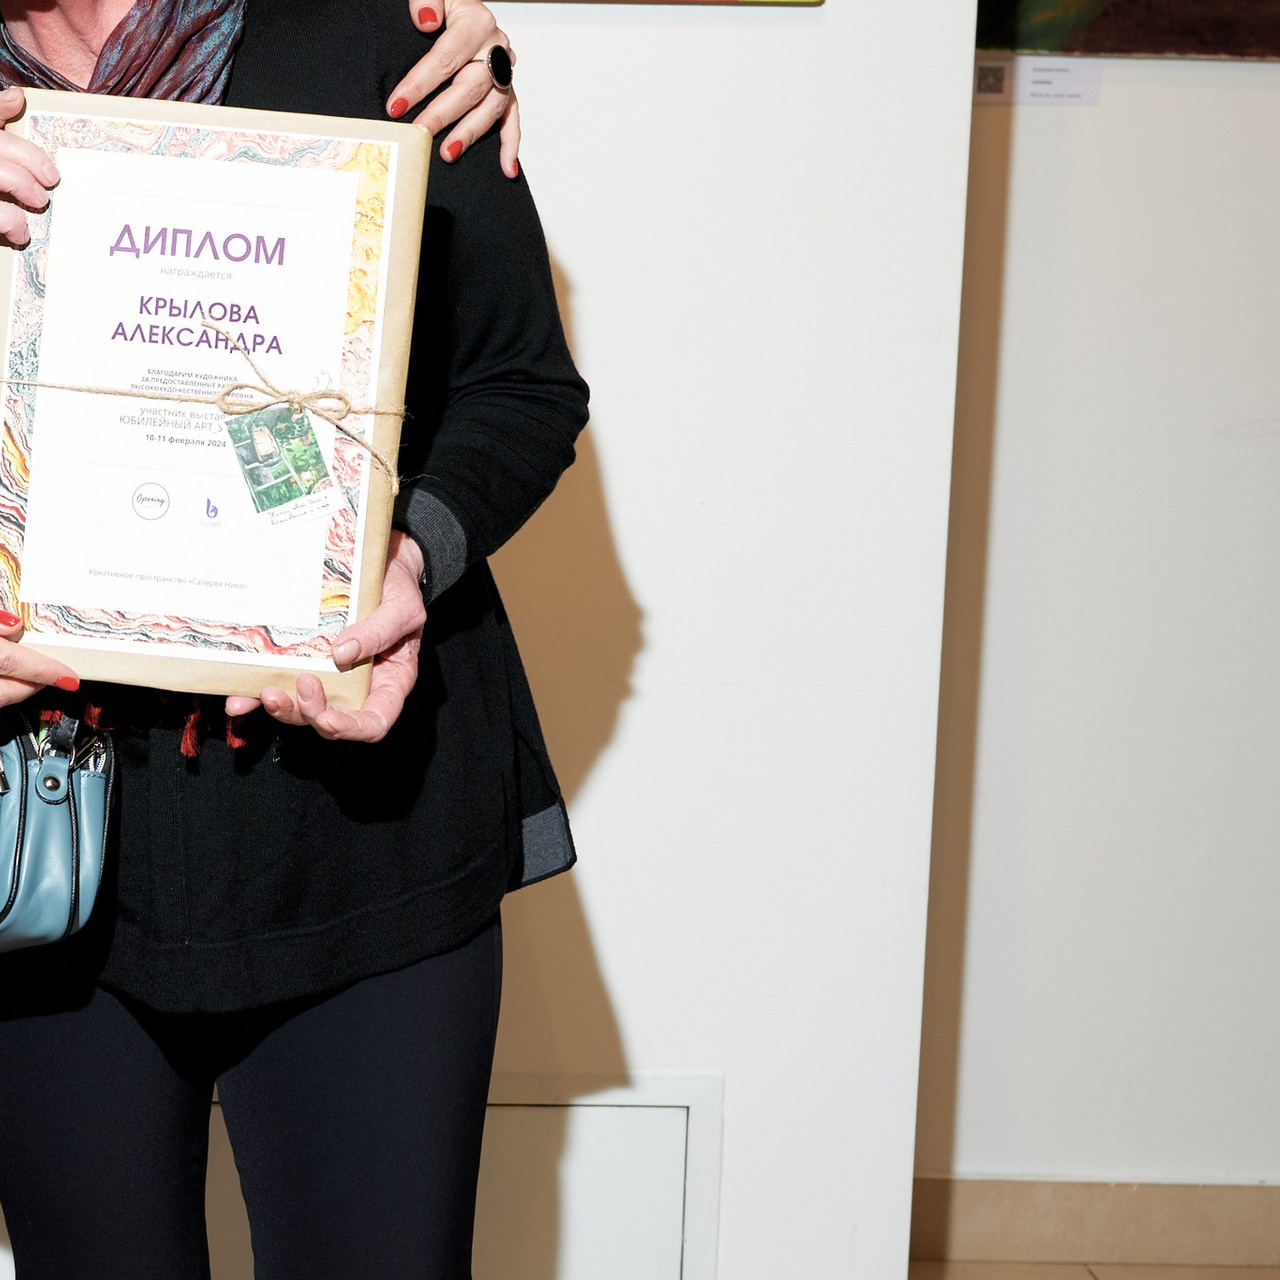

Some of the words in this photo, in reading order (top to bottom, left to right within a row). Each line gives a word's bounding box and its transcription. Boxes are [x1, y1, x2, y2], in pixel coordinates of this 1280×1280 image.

[109, 224, 286, 266] ДИПЛОМ
[160, 267, 232, 280] награждается
[139, 295, 260, 325] КРЫЛОВА
[111, 322, 283, 355] АЛЕКСАНДРА
[147, 368, 193, 379] БЛАГОДАРИМ
[194, 373, 238, 382] ХУДОЖНИКА
[130, 384, 220, 396] ВЫСОКОХУДОЖЕСТВЕННОГ
[151, 377, 216, 389] ПРЕДОСТАВЛЕННЫЕ
[140, 407, 187, 419] участник
[119, 415, 191, 430] ЮБИЛЕЙНЫЙ
[146, 434, 166, 442] 10-11
[168, 436, 205, 446] февраля
[207, 439, 227, 448] 2024
[136, 493, 165, 507] Opening
[89, 569, 134, 580] Креативное
[135, 574, 187, 584] пространство
